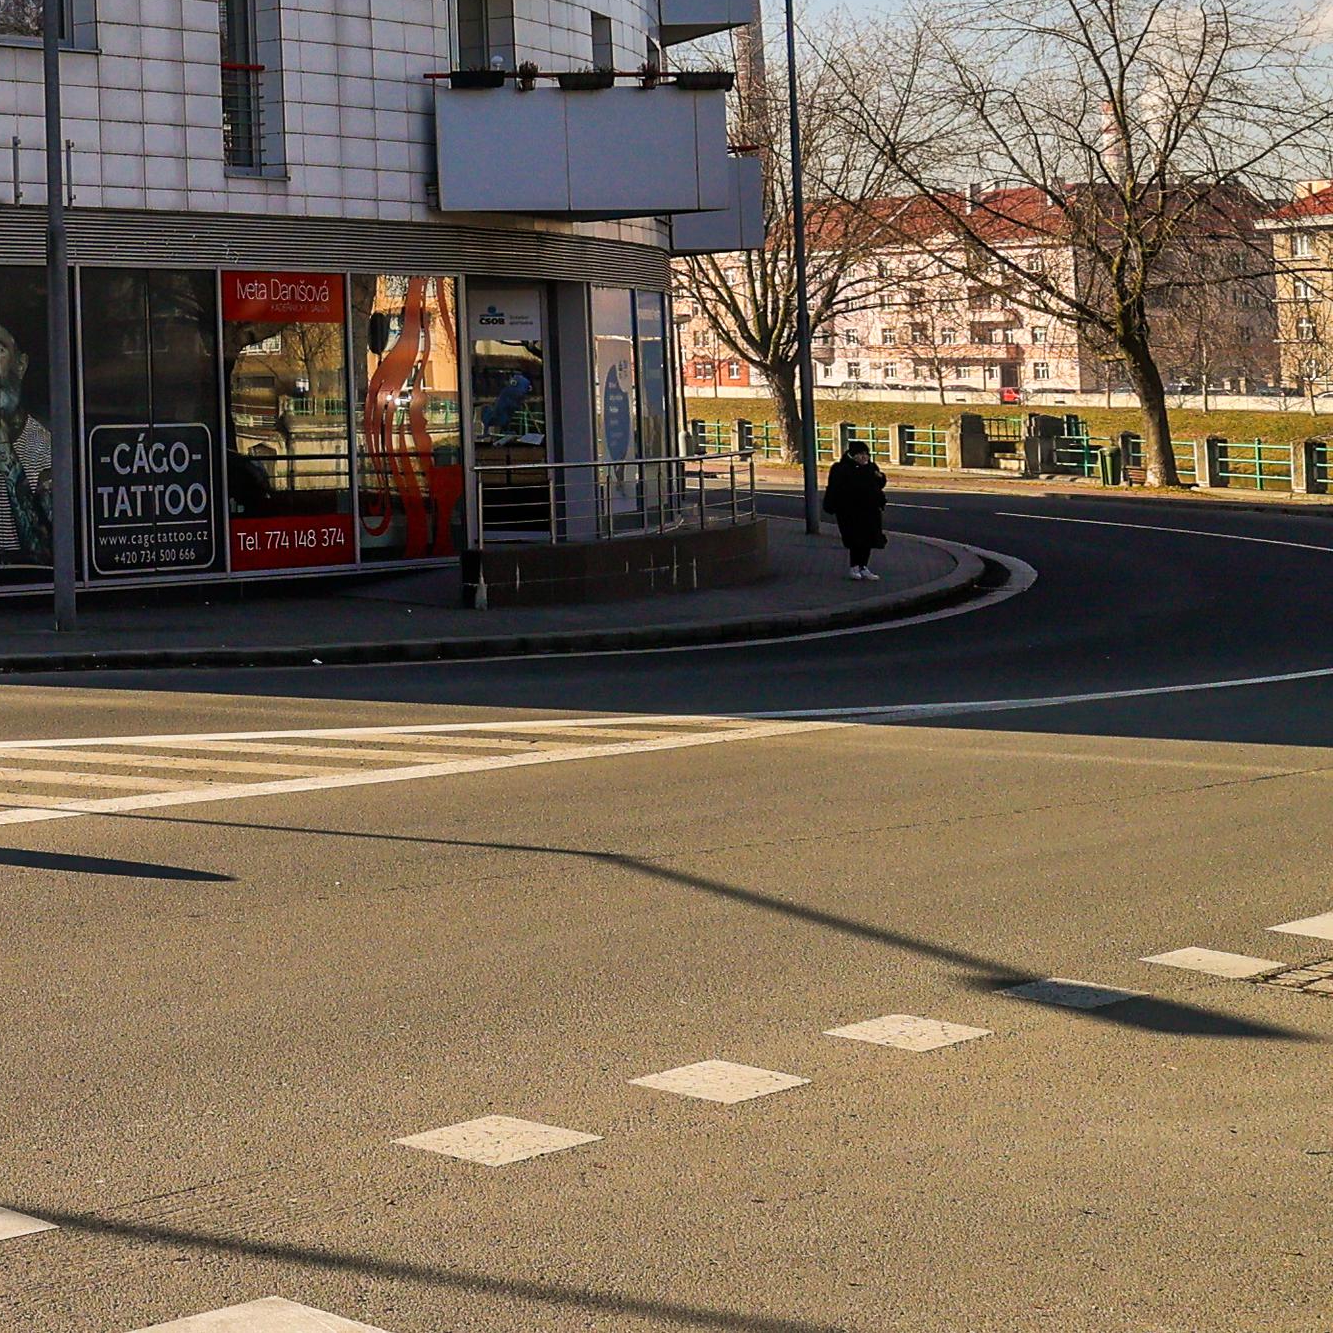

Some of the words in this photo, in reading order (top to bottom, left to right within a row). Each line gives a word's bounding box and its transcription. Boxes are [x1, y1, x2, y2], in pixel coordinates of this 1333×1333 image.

[236, 278, 267, 300] Iveta
[270, 278, 329, 302] Danišová
[97, 483, 208, 518] TATTOO
[237, 532, 262, 551] Tel.
[264, 531, 290, 549] 774
[294, 529, 317, 548] 148
[320, 528, 345, 547] 374
[114, 552, 138, 565] +420
[159, 550, 176, 561] 500
[179, 548, 195, 560] 666
